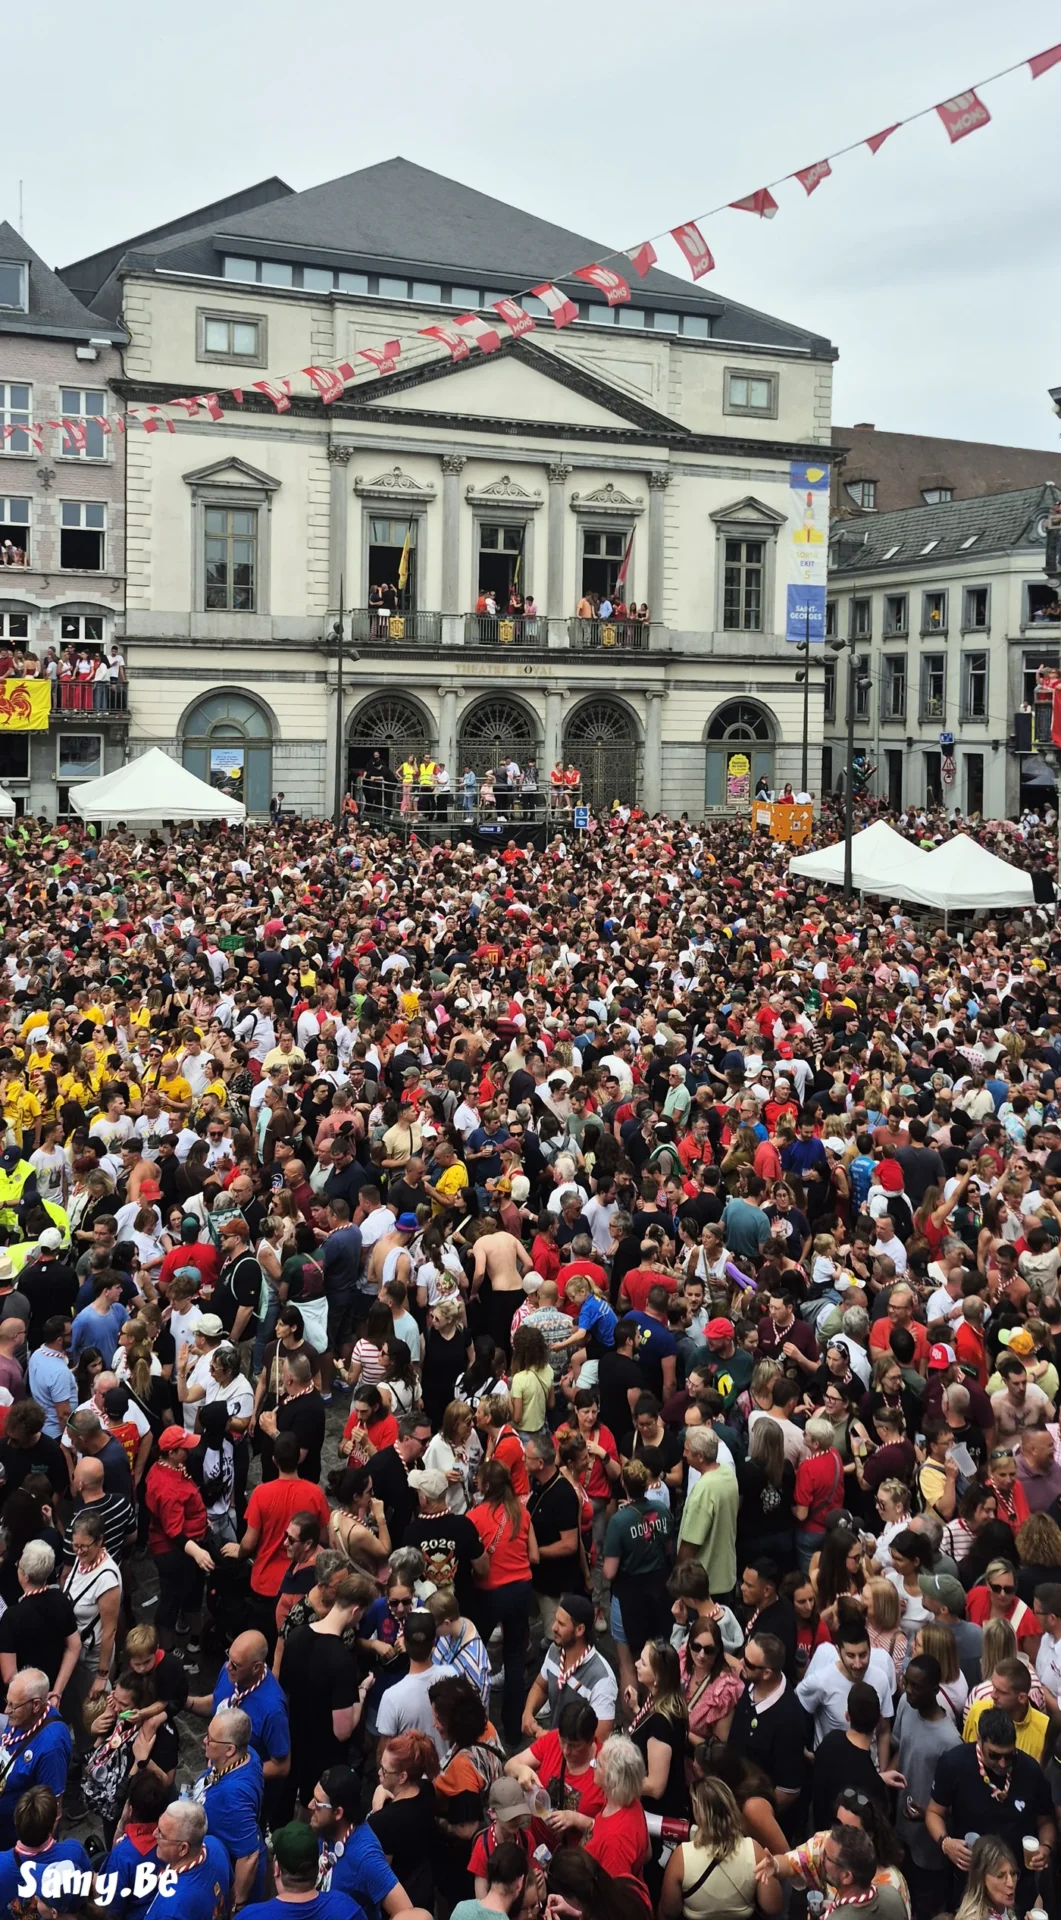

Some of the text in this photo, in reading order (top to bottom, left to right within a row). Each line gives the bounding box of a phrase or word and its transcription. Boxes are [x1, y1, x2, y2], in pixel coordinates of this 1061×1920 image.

[607, 287, 627, 301] MONS
[511, 317, 533, 333] MONS
[452, 344, 467, 358] MONS
[379, 360, 394, 372] MONS
[324, 384, 344, 401] MONS
[804, 570, 810, 580] 5
[790, 612, 822, 620] GEORGES
[516, 665, 555, 675] ROYAL
[420, 1538, 456, 1552] 2026
